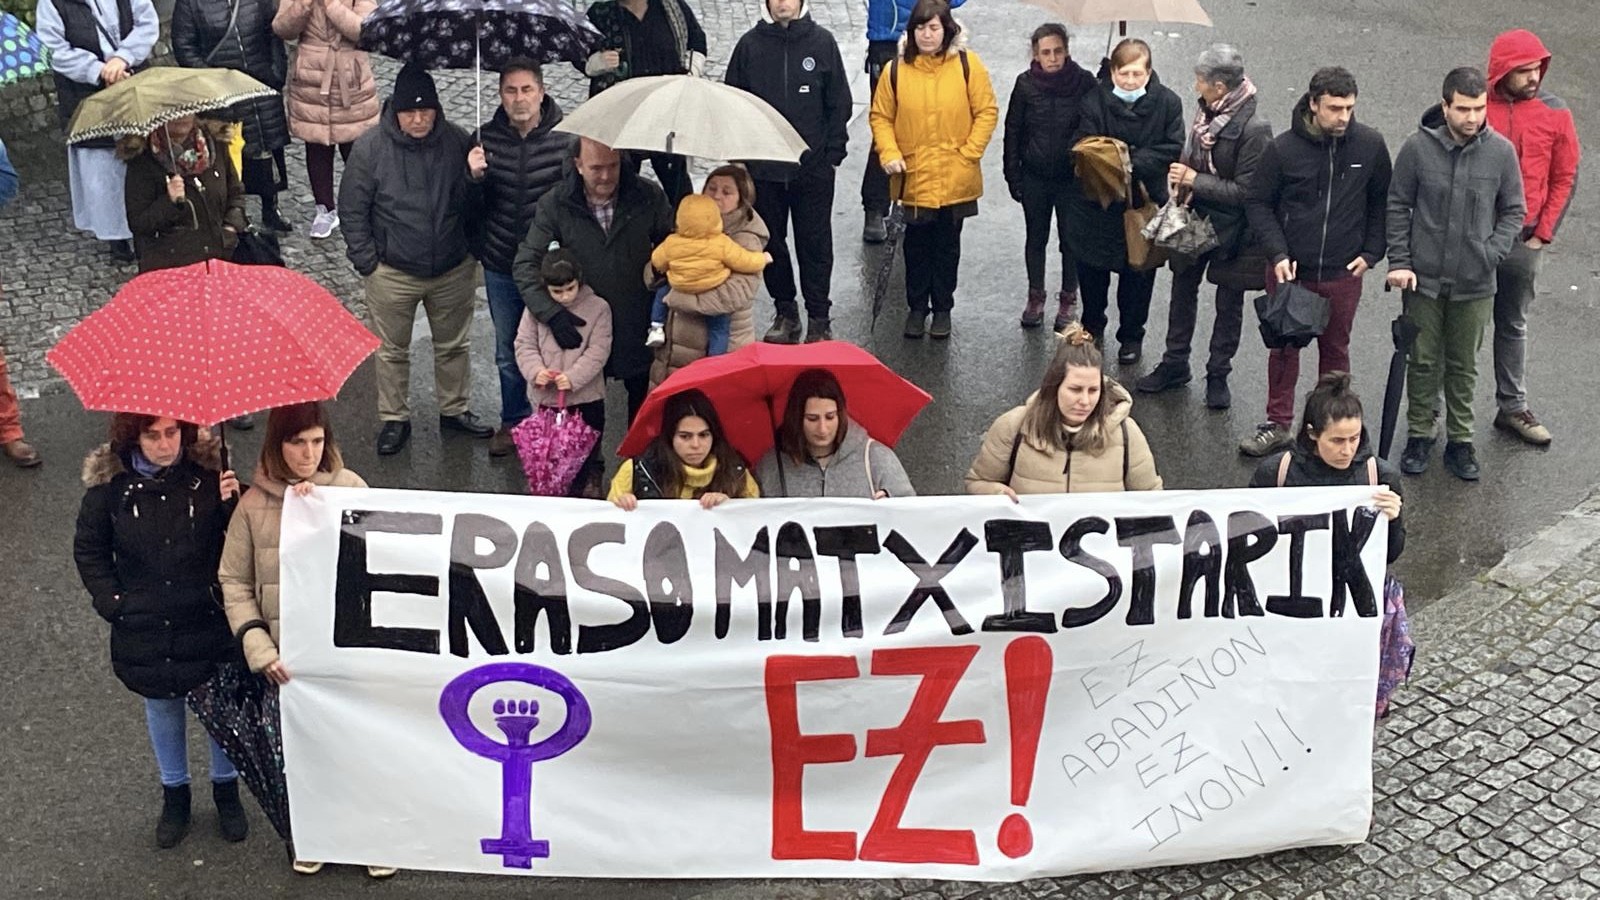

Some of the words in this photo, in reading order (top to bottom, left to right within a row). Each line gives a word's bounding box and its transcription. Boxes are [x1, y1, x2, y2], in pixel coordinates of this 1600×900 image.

[333, 509, 693, 658] ERASO
[713, 506, 1379, 643] MATXISTARIK
[1079, 639, 1171, 710] EZ
[764, 635, 1054, 866] EZ!
[1131, 707, 1312, 852] INON!!
[1134, 731, 1210, 789] EZ
